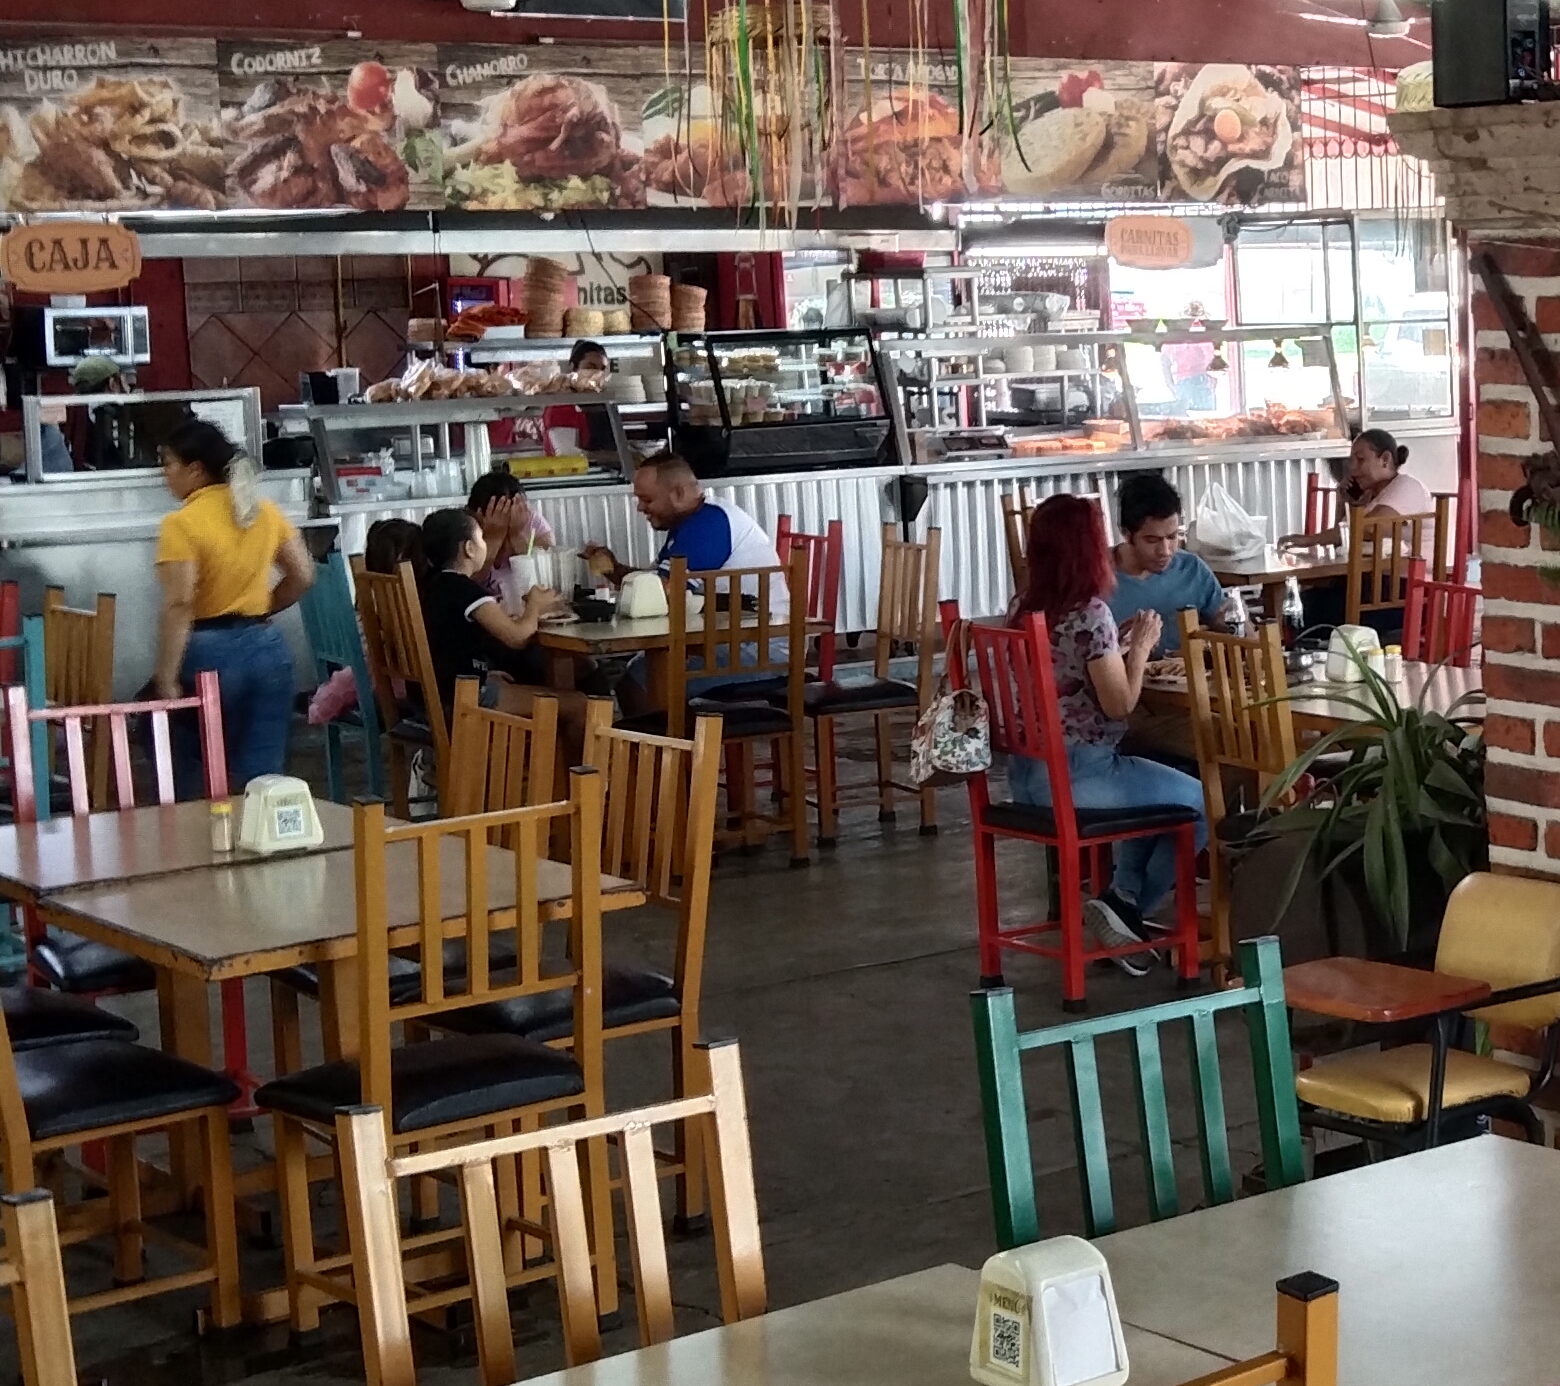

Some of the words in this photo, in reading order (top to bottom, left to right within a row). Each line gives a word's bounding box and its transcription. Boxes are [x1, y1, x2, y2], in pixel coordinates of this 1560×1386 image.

[24, 69, 78, 95] DURO
[445, 53, 529, 86] CHAMORRO
[24, 236, 120, 273] CAJA
